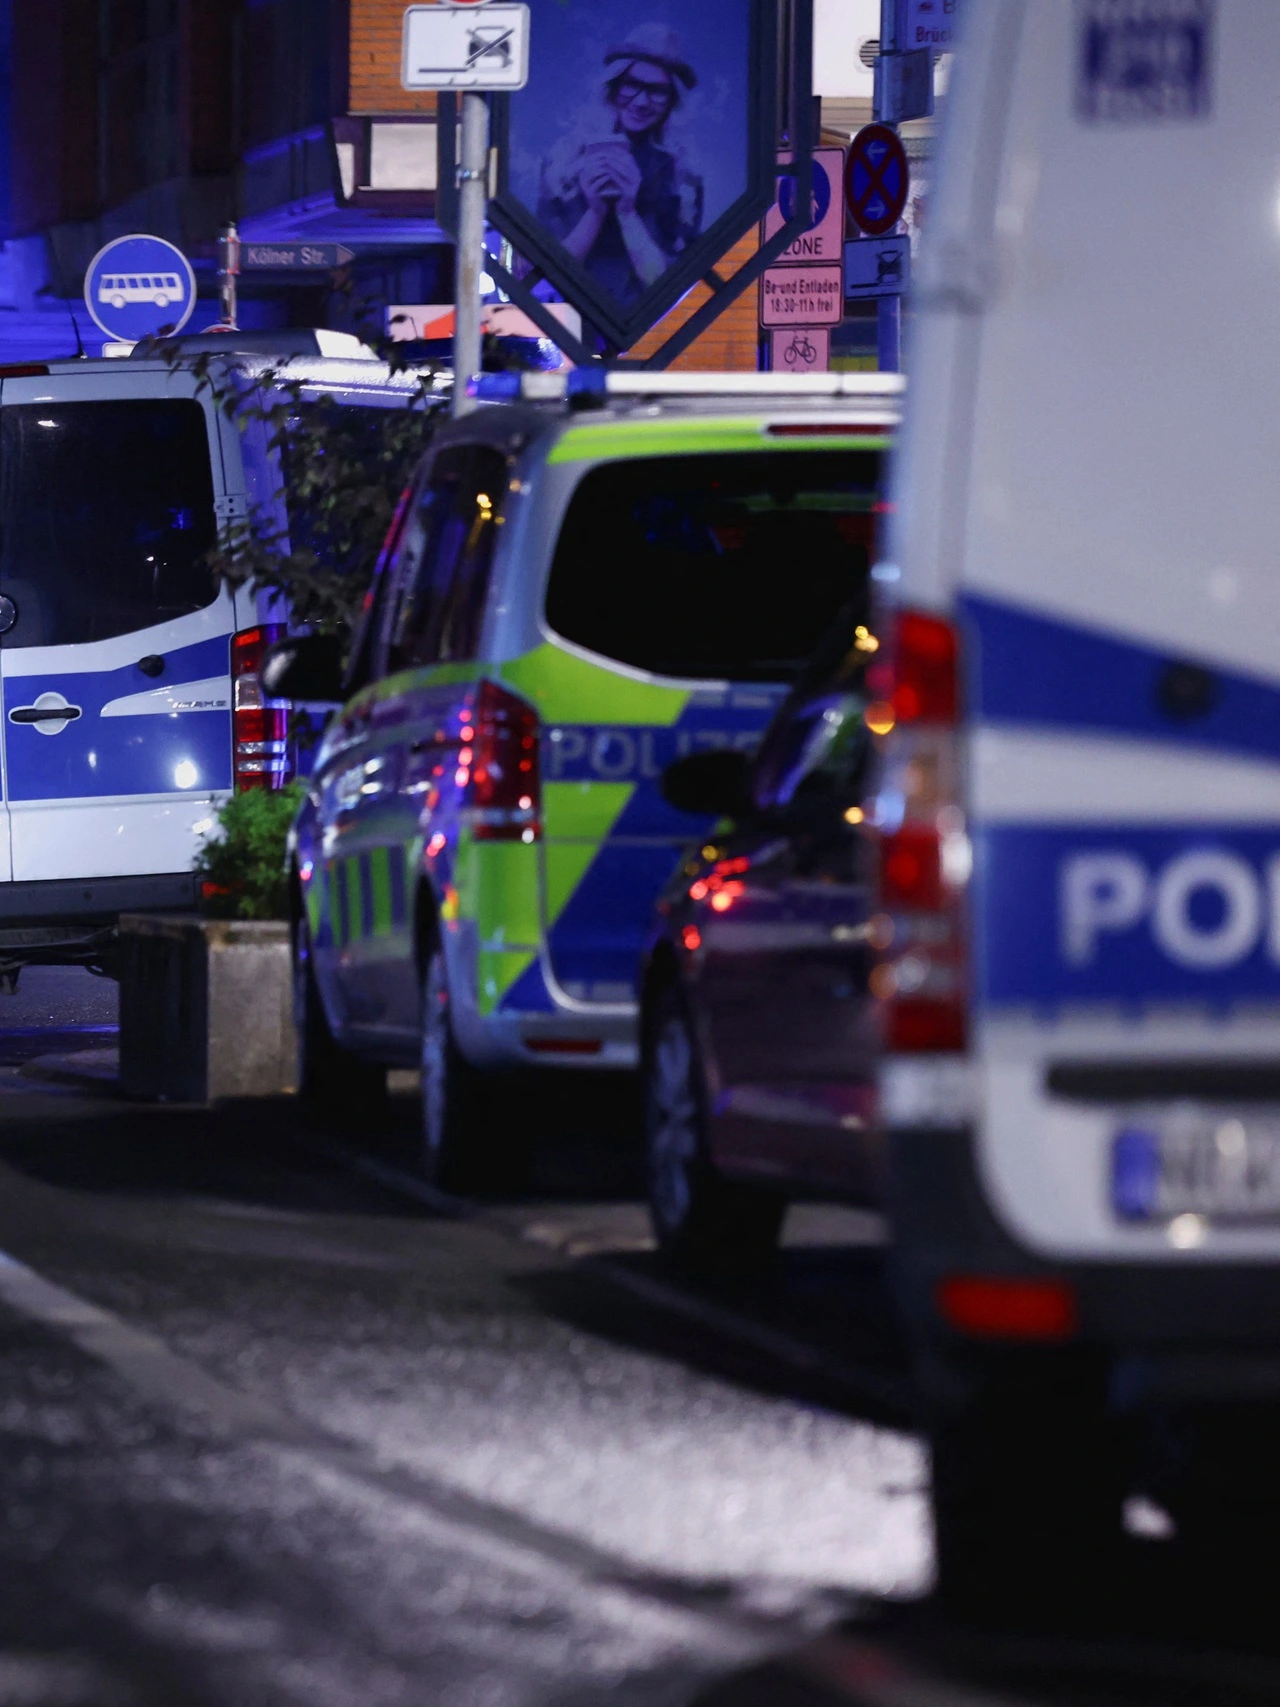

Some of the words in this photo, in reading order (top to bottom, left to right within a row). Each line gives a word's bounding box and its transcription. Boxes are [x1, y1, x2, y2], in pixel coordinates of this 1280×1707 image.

[247, 246, 295, 265] Kölner
[300, 246, 328, 265] Str.
[799, 279, 839, 295] Entladen
[1060, 850, 1280, 970] PO
